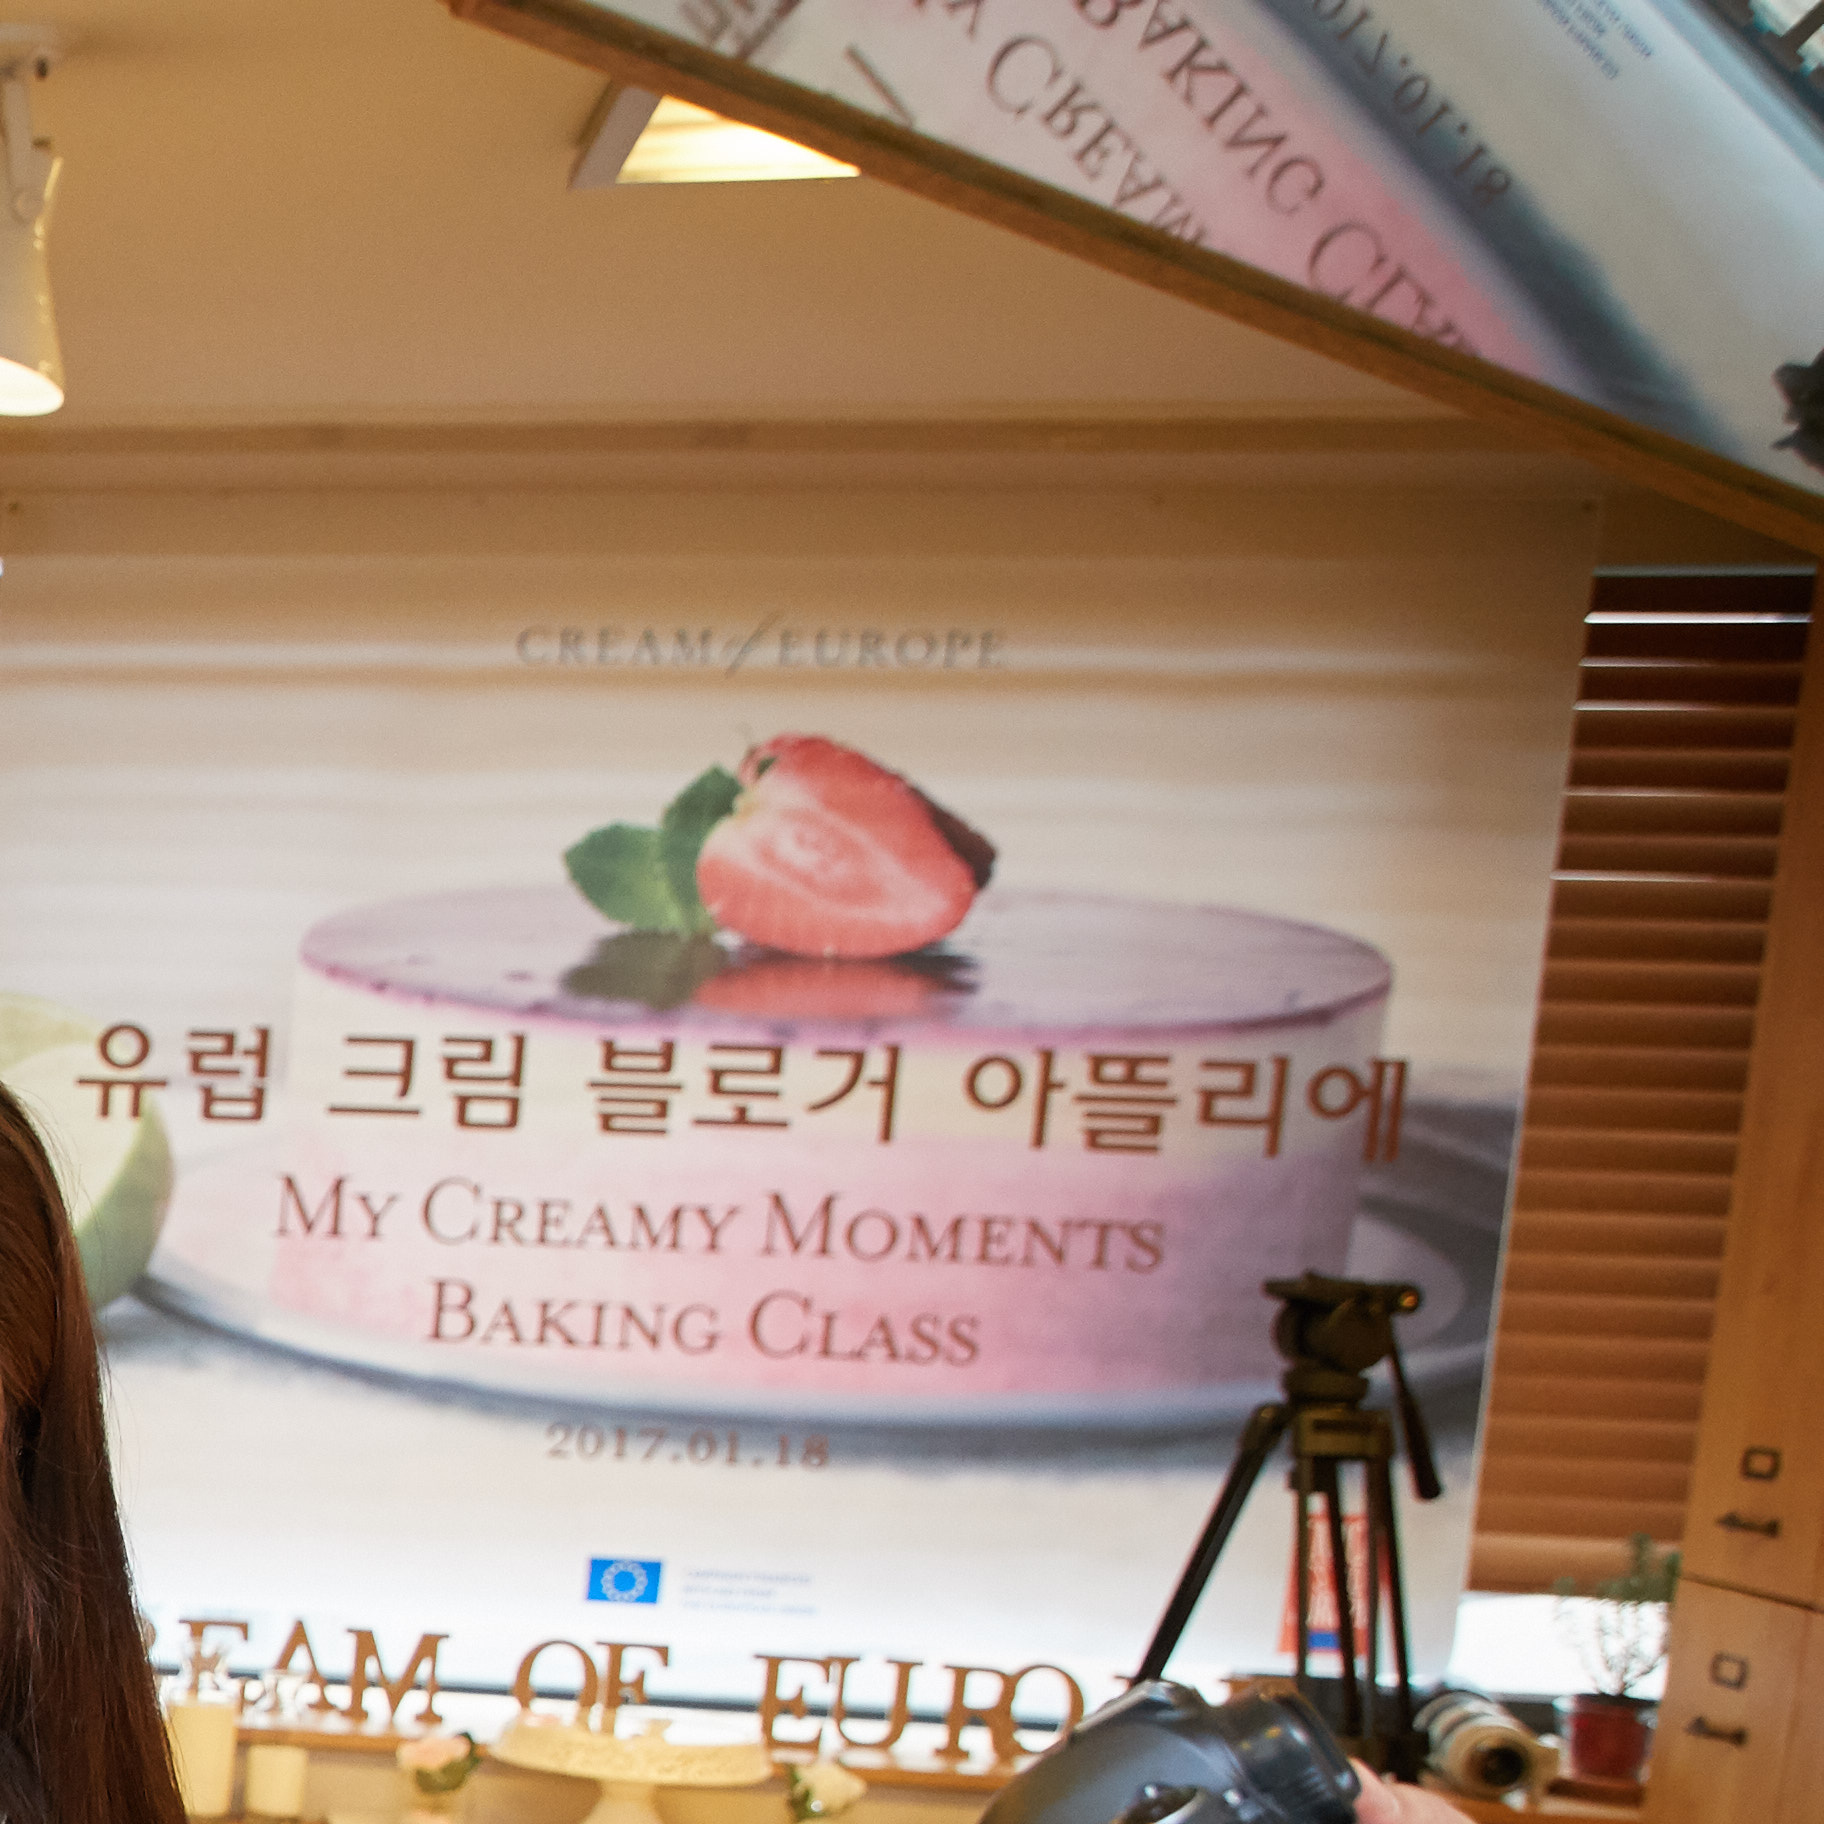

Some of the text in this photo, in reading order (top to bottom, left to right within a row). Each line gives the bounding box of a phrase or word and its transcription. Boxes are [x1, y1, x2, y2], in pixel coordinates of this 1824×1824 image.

[776, 626, 1008, 670] EUROPE
[76, 1023, 1409, 1163] 유럽 크림 블로거 아뜰리에
[420, 1177, 739, 1256] CREAMY
[758, 1193, 1166, 1276] MOMENTS
[425, 1277, 982, 1366] BAKING CLASS
[545, 1424, 832, 1468] 2017.01.18
